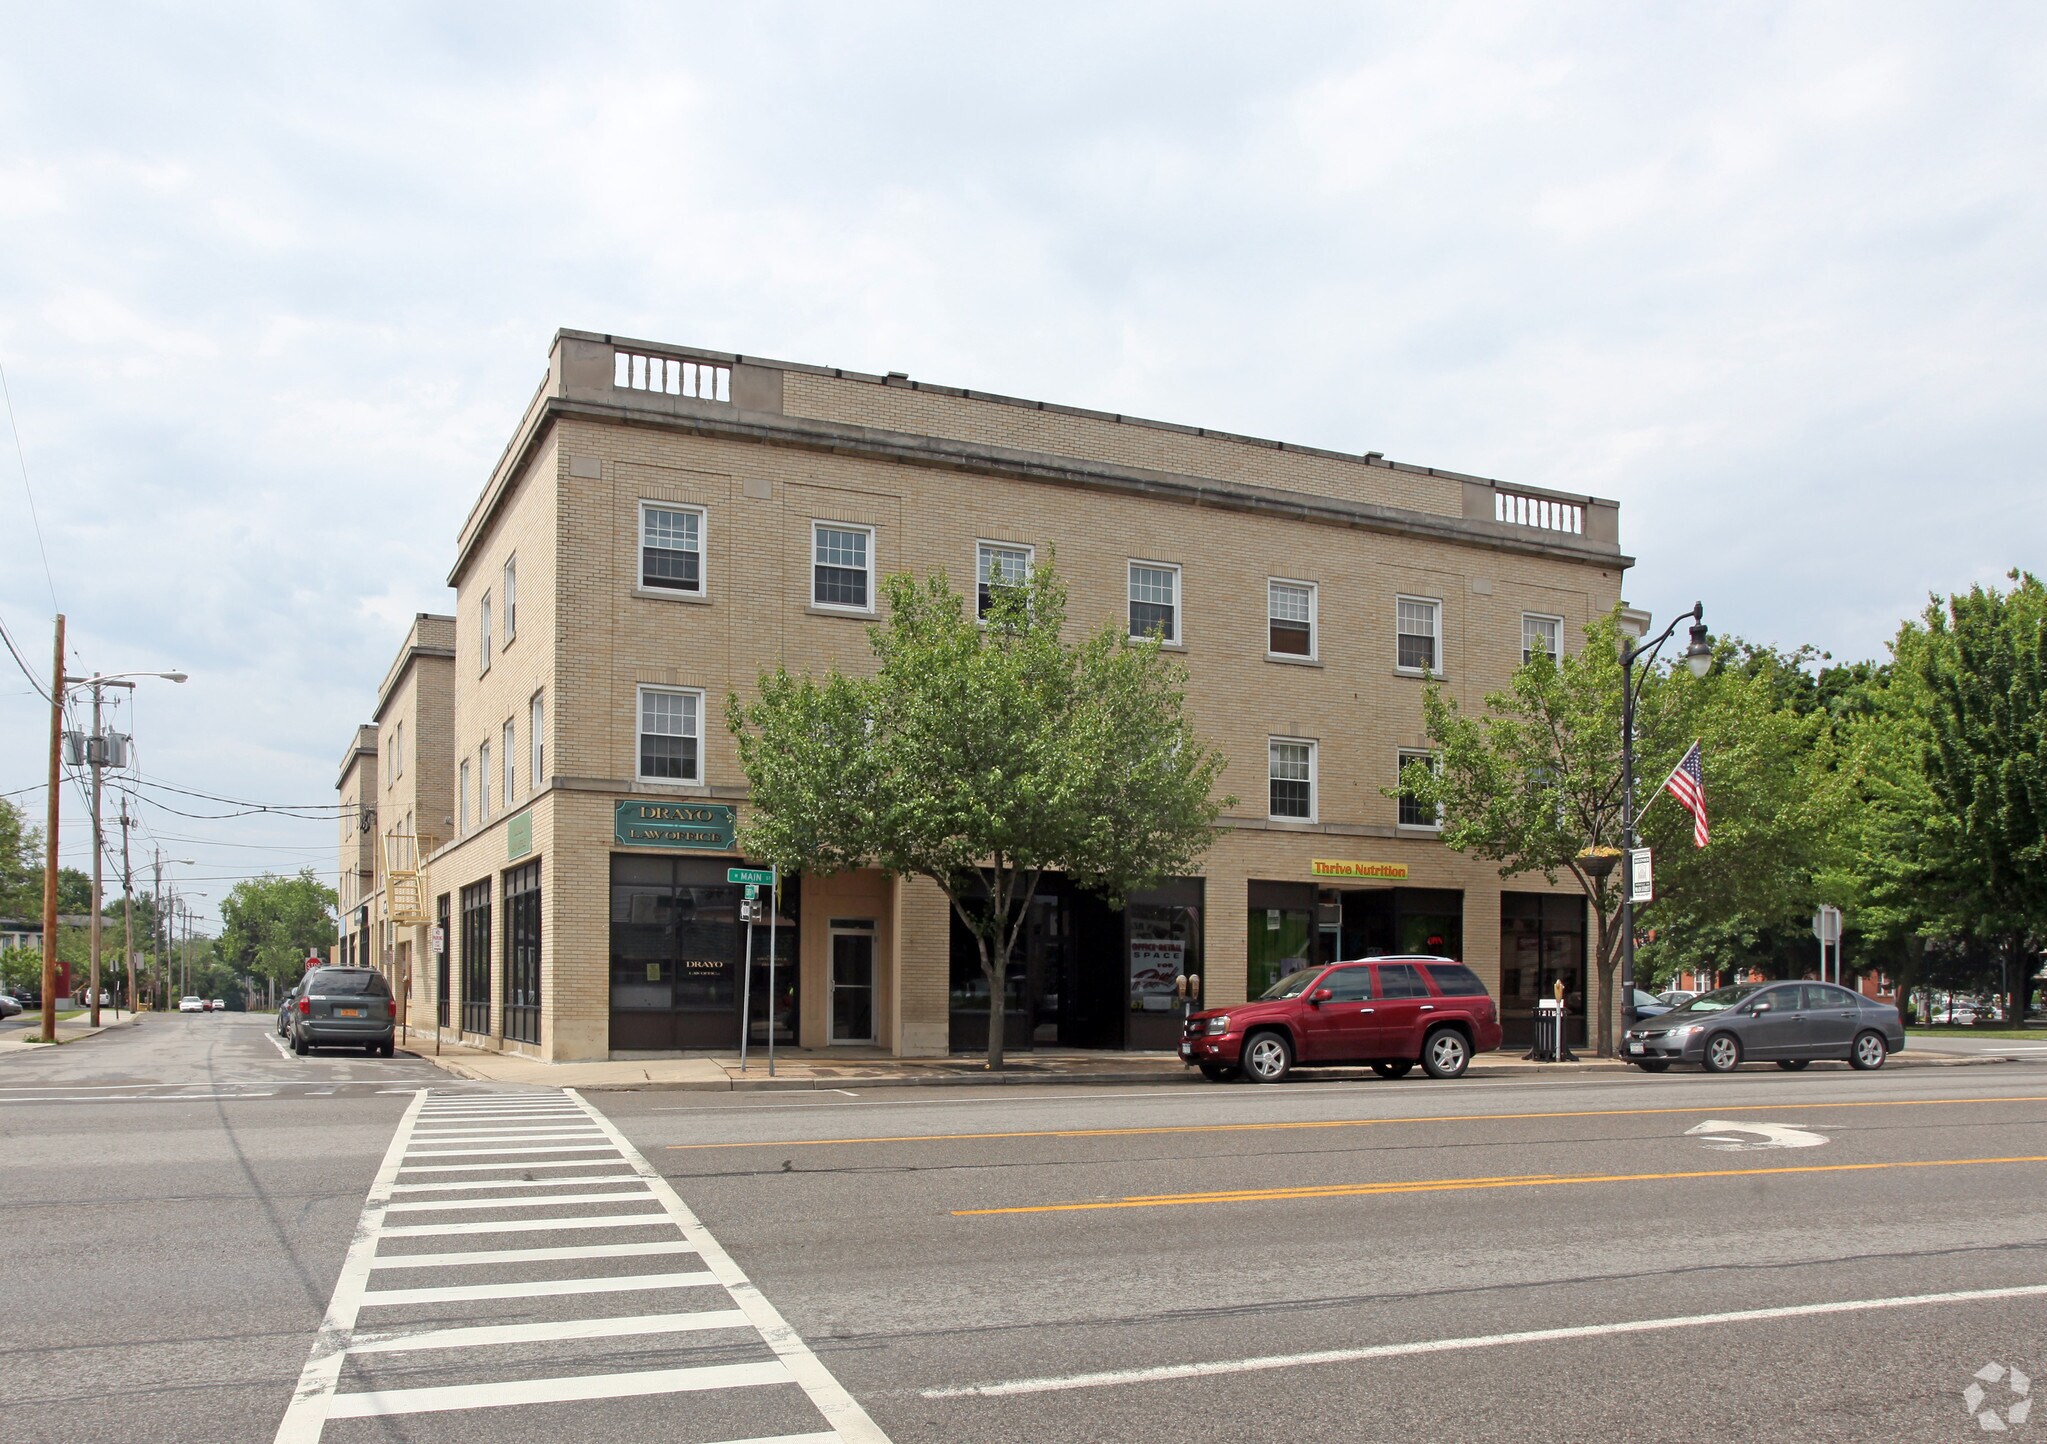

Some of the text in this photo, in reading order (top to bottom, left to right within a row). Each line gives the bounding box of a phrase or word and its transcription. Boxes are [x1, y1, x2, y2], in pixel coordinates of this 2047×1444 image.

[640, 806, 713, 823] DRAYO
[630, 829, 722, 843] LAW OFFICE
[740, 872, 762, 882] MAIN
[1315, 861, 1406, 878] Thrive Nutrition
